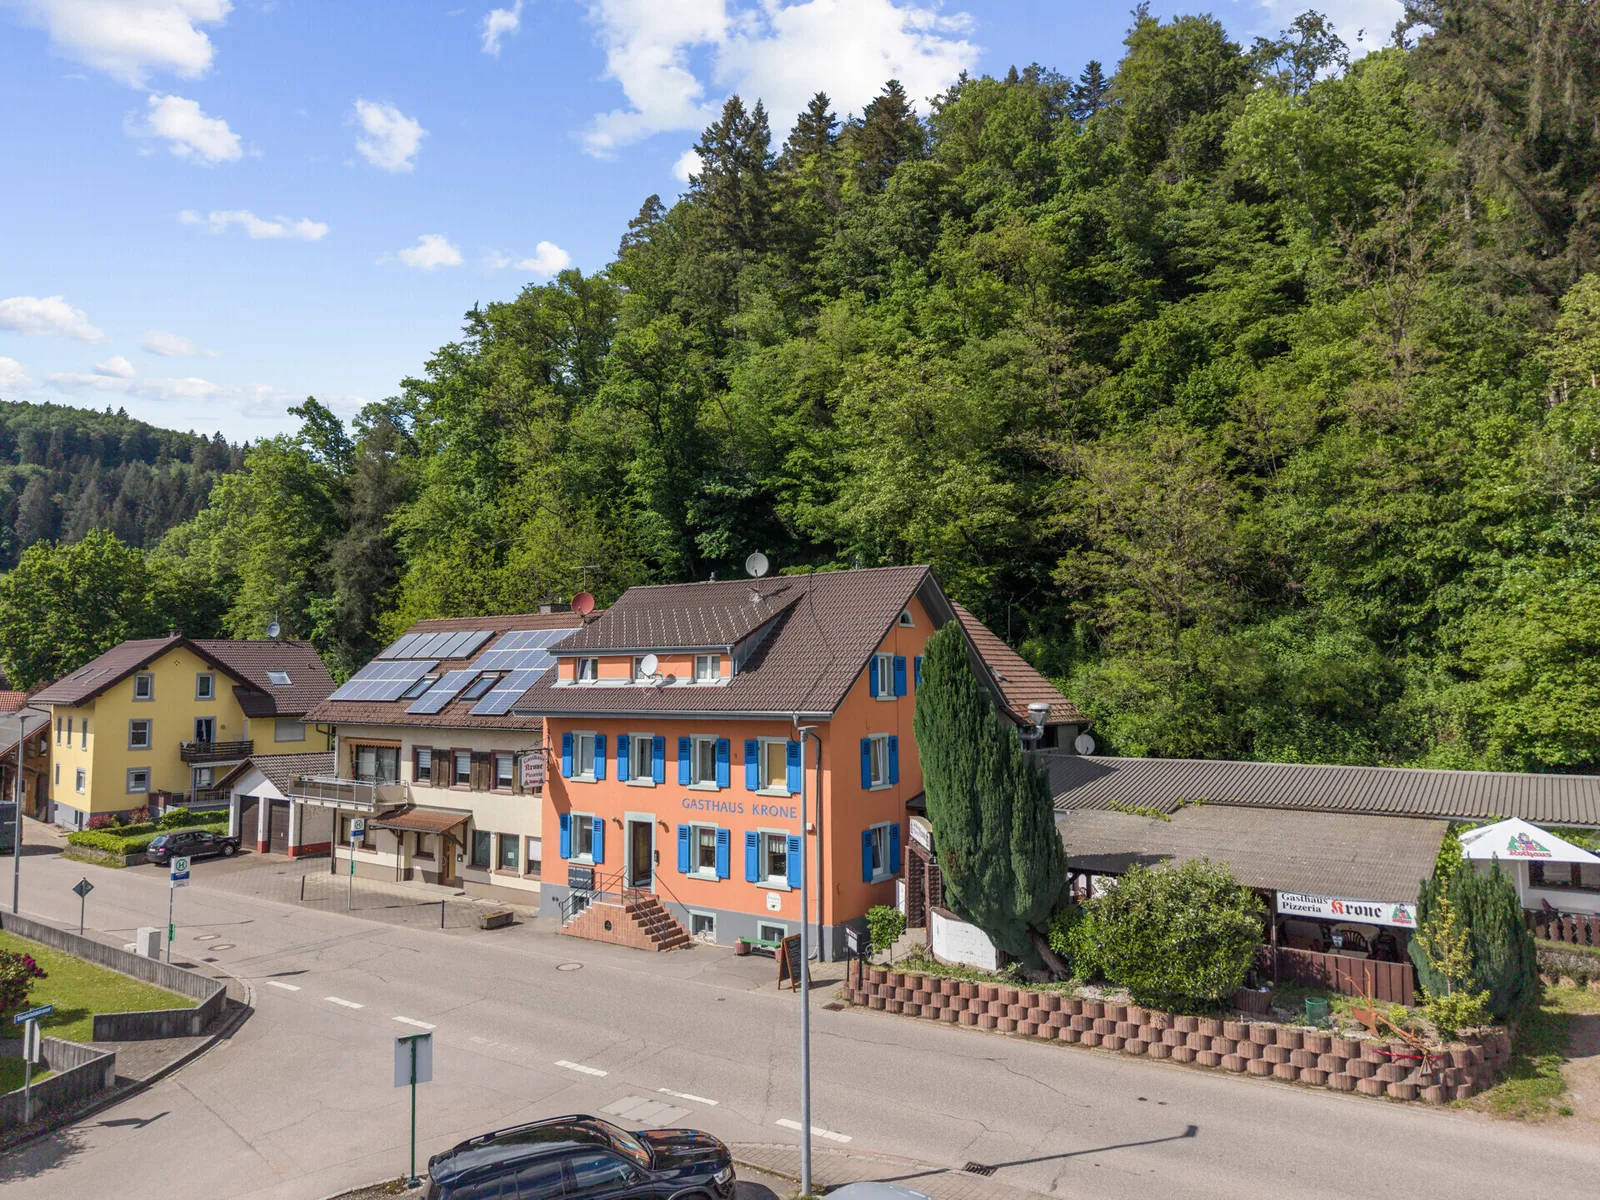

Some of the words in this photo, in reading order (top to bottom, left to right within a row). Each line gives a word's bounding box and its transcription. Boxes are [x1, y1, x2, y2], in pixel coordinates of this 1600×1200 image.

[682, 798, 744, 814] GASTHAUS
[752, 804, 798, 818] KRONE
[1508, 850, 1553, 858] Rothaus
[1281, 893, 1328, 904] Gasthaus
[1282, 902, 1322, 913] Pizzeria
[1331, 899, 1382, 918] Krone
